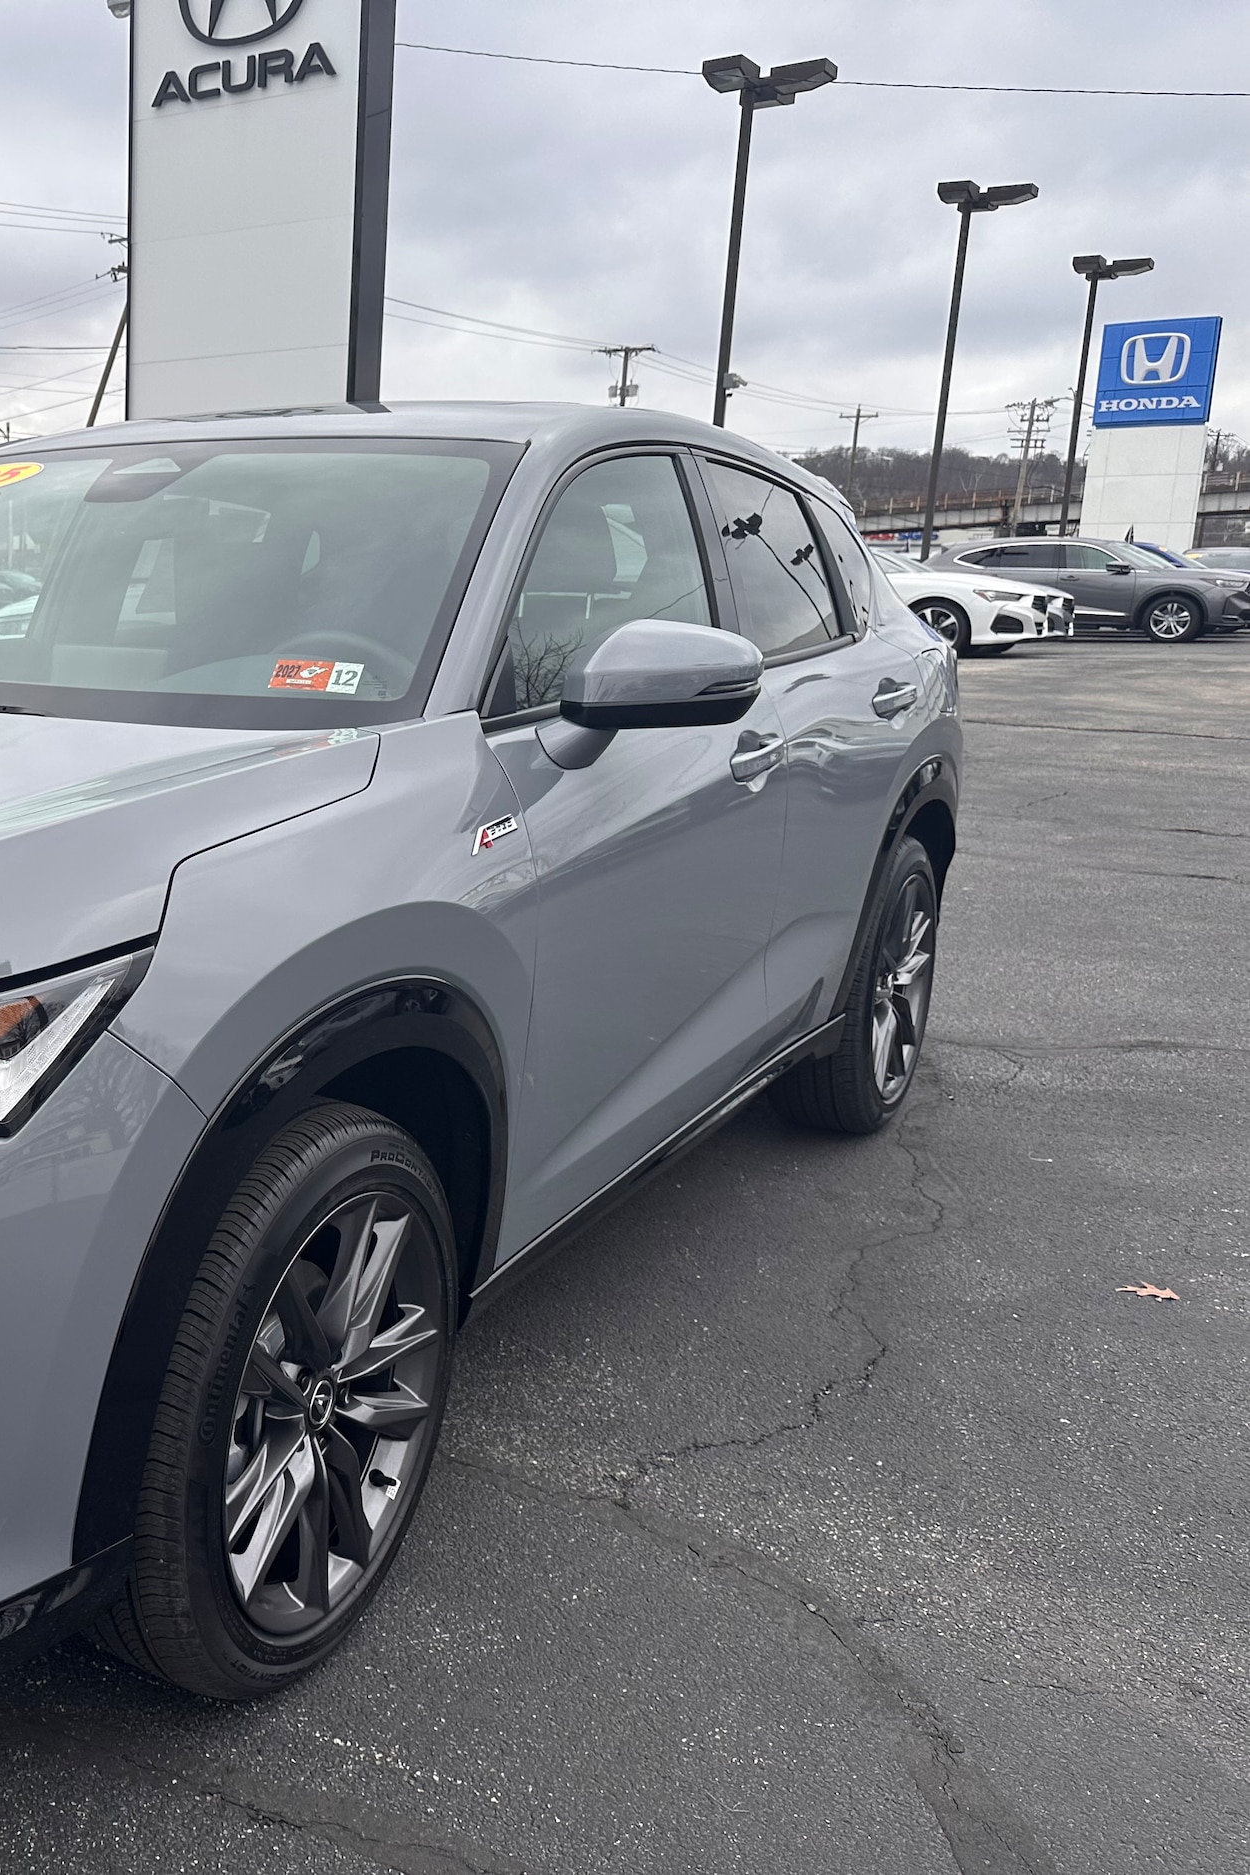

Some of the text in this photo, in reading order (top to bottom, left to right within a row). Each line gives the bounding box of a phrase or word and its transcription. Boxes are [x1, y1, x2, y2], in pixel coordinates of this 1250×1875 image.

[151, 42, 337, 108] ACURA
[1098, 395, 1201, 412] HONDA
[275, 664, 302, 678] 2027
[331, 669, 358, 686] 12
